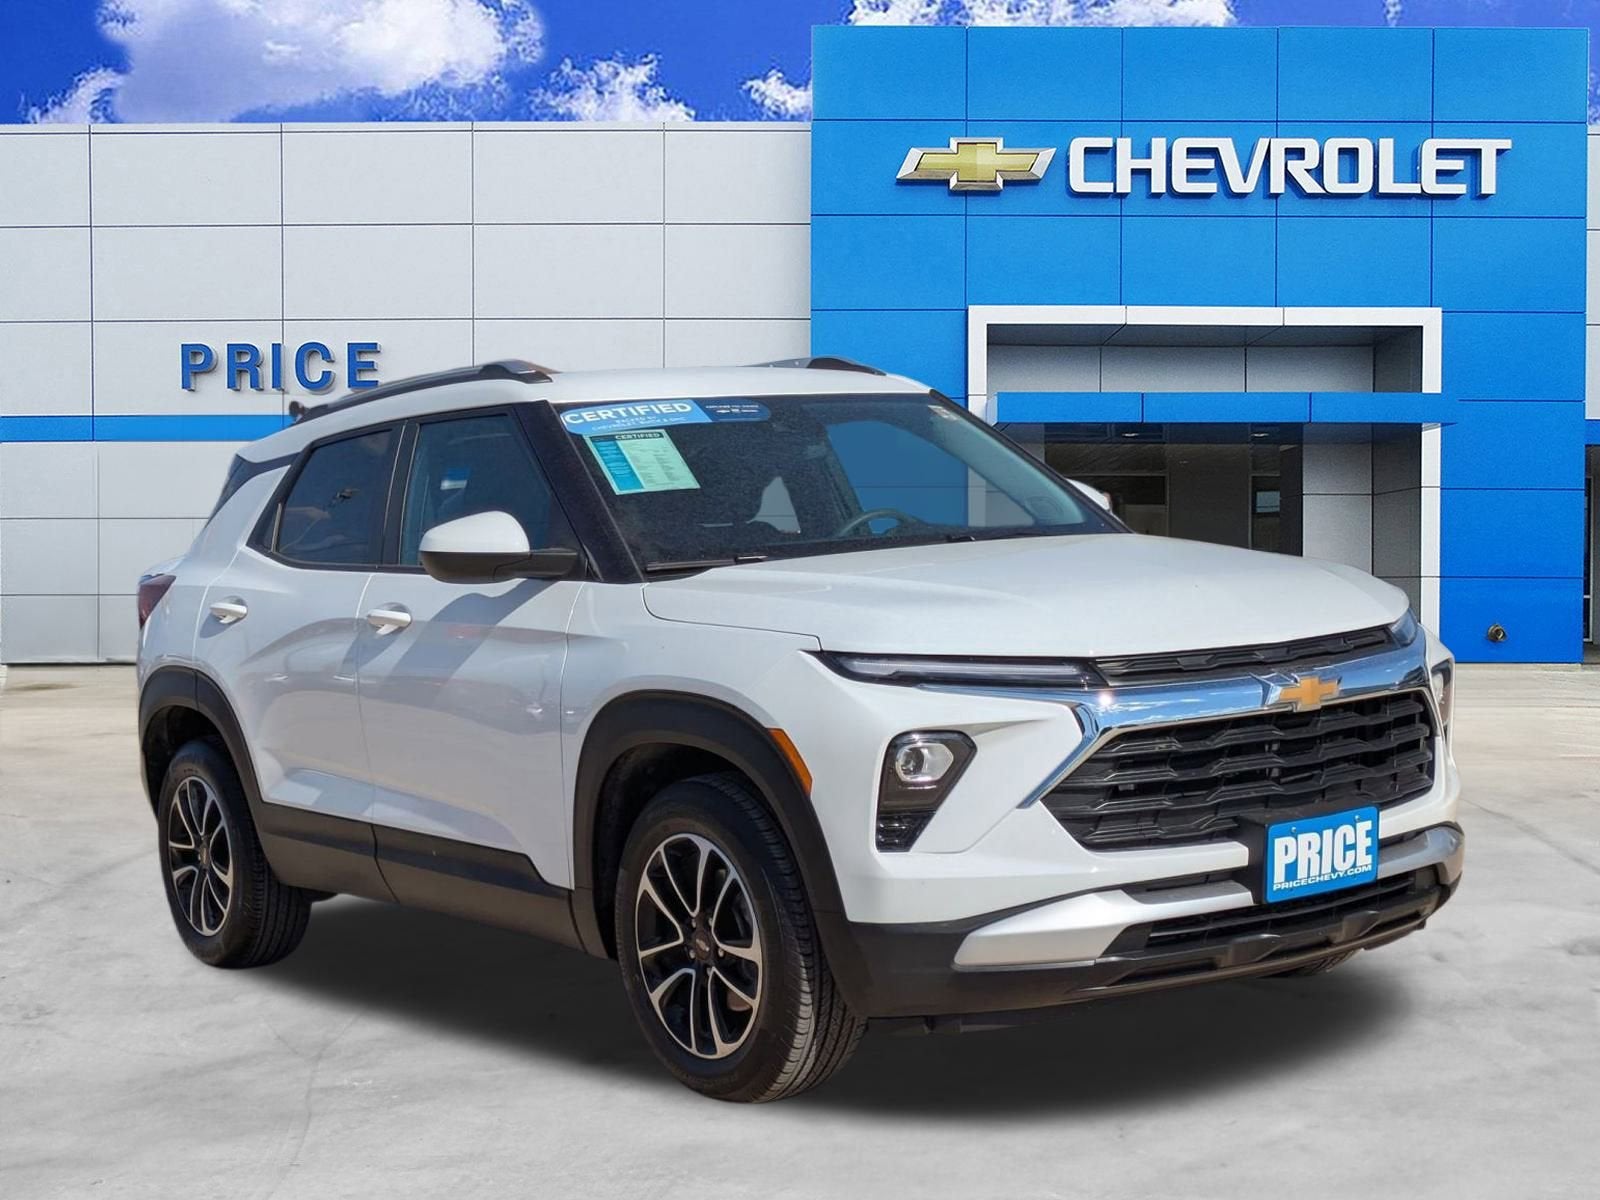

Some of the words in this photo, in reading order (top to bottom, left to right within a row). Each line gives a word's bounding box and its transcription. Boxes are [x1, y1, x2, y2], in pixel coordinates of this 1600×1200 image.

[1069, 137, 1512, 195] CHEVROLET
[181, 342, 381, 392] PRICE
[564, 402, 693, 424] CERTIFIED
[615, 431, 661, 440] CERTIFIED
[1273, 820, 1373, 884] PRICE
[1273, 864, 1373, 892] PRICECHEVY.COM
